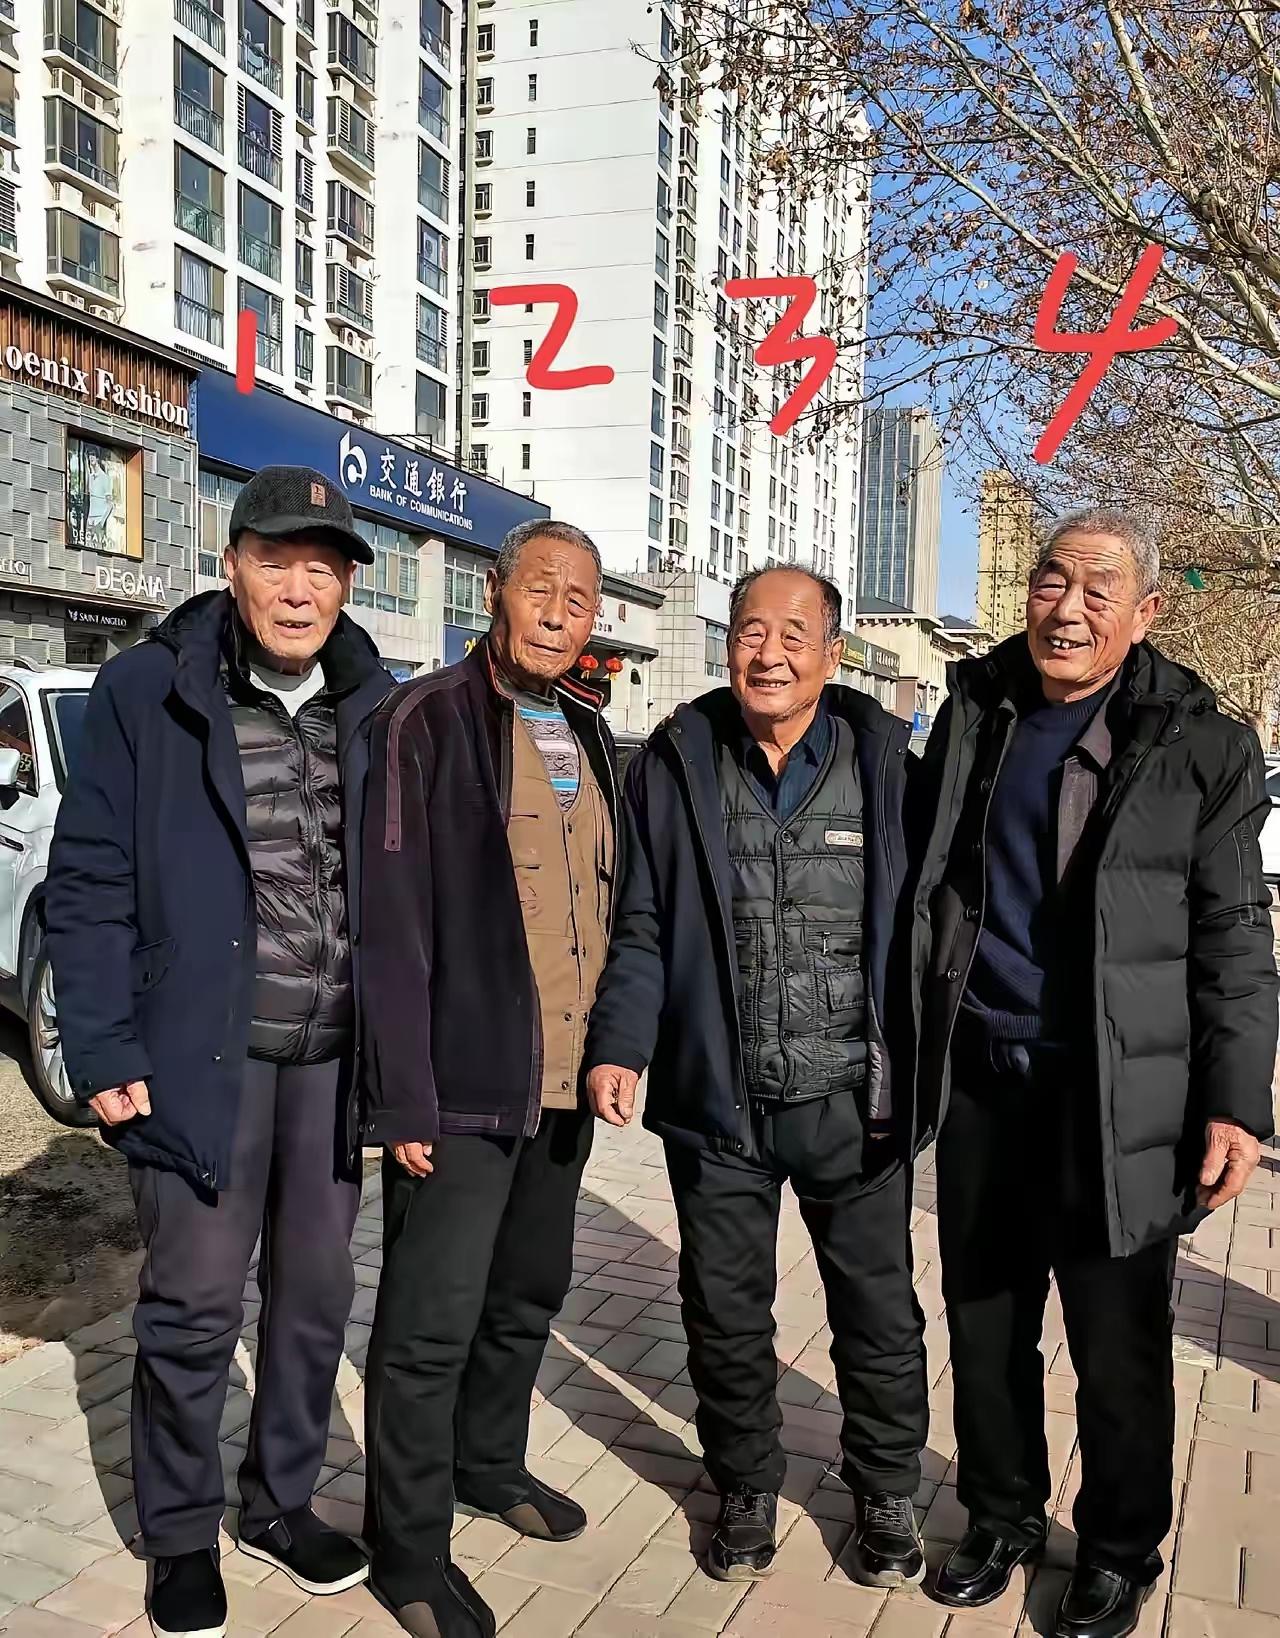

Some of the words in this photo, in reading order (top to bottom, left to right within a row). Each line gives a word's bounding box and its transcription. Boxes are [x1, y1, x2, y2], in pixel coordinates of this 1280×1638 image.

[0, 345, 90, 395] oenix
[95, 367, 190, 429] Fashion
[379, 447, 467, 513] 交通銀行
[369, 484, 393, 503] BANK
[396, 494, 407, 507] OF
[410, 499, 473, 530] COMMUNICATIONS
[96, 565, 166, 602] DEGAIA
[79, 612, 99, 624] SAINT
[100, 615, 127, 627] ANGELO
